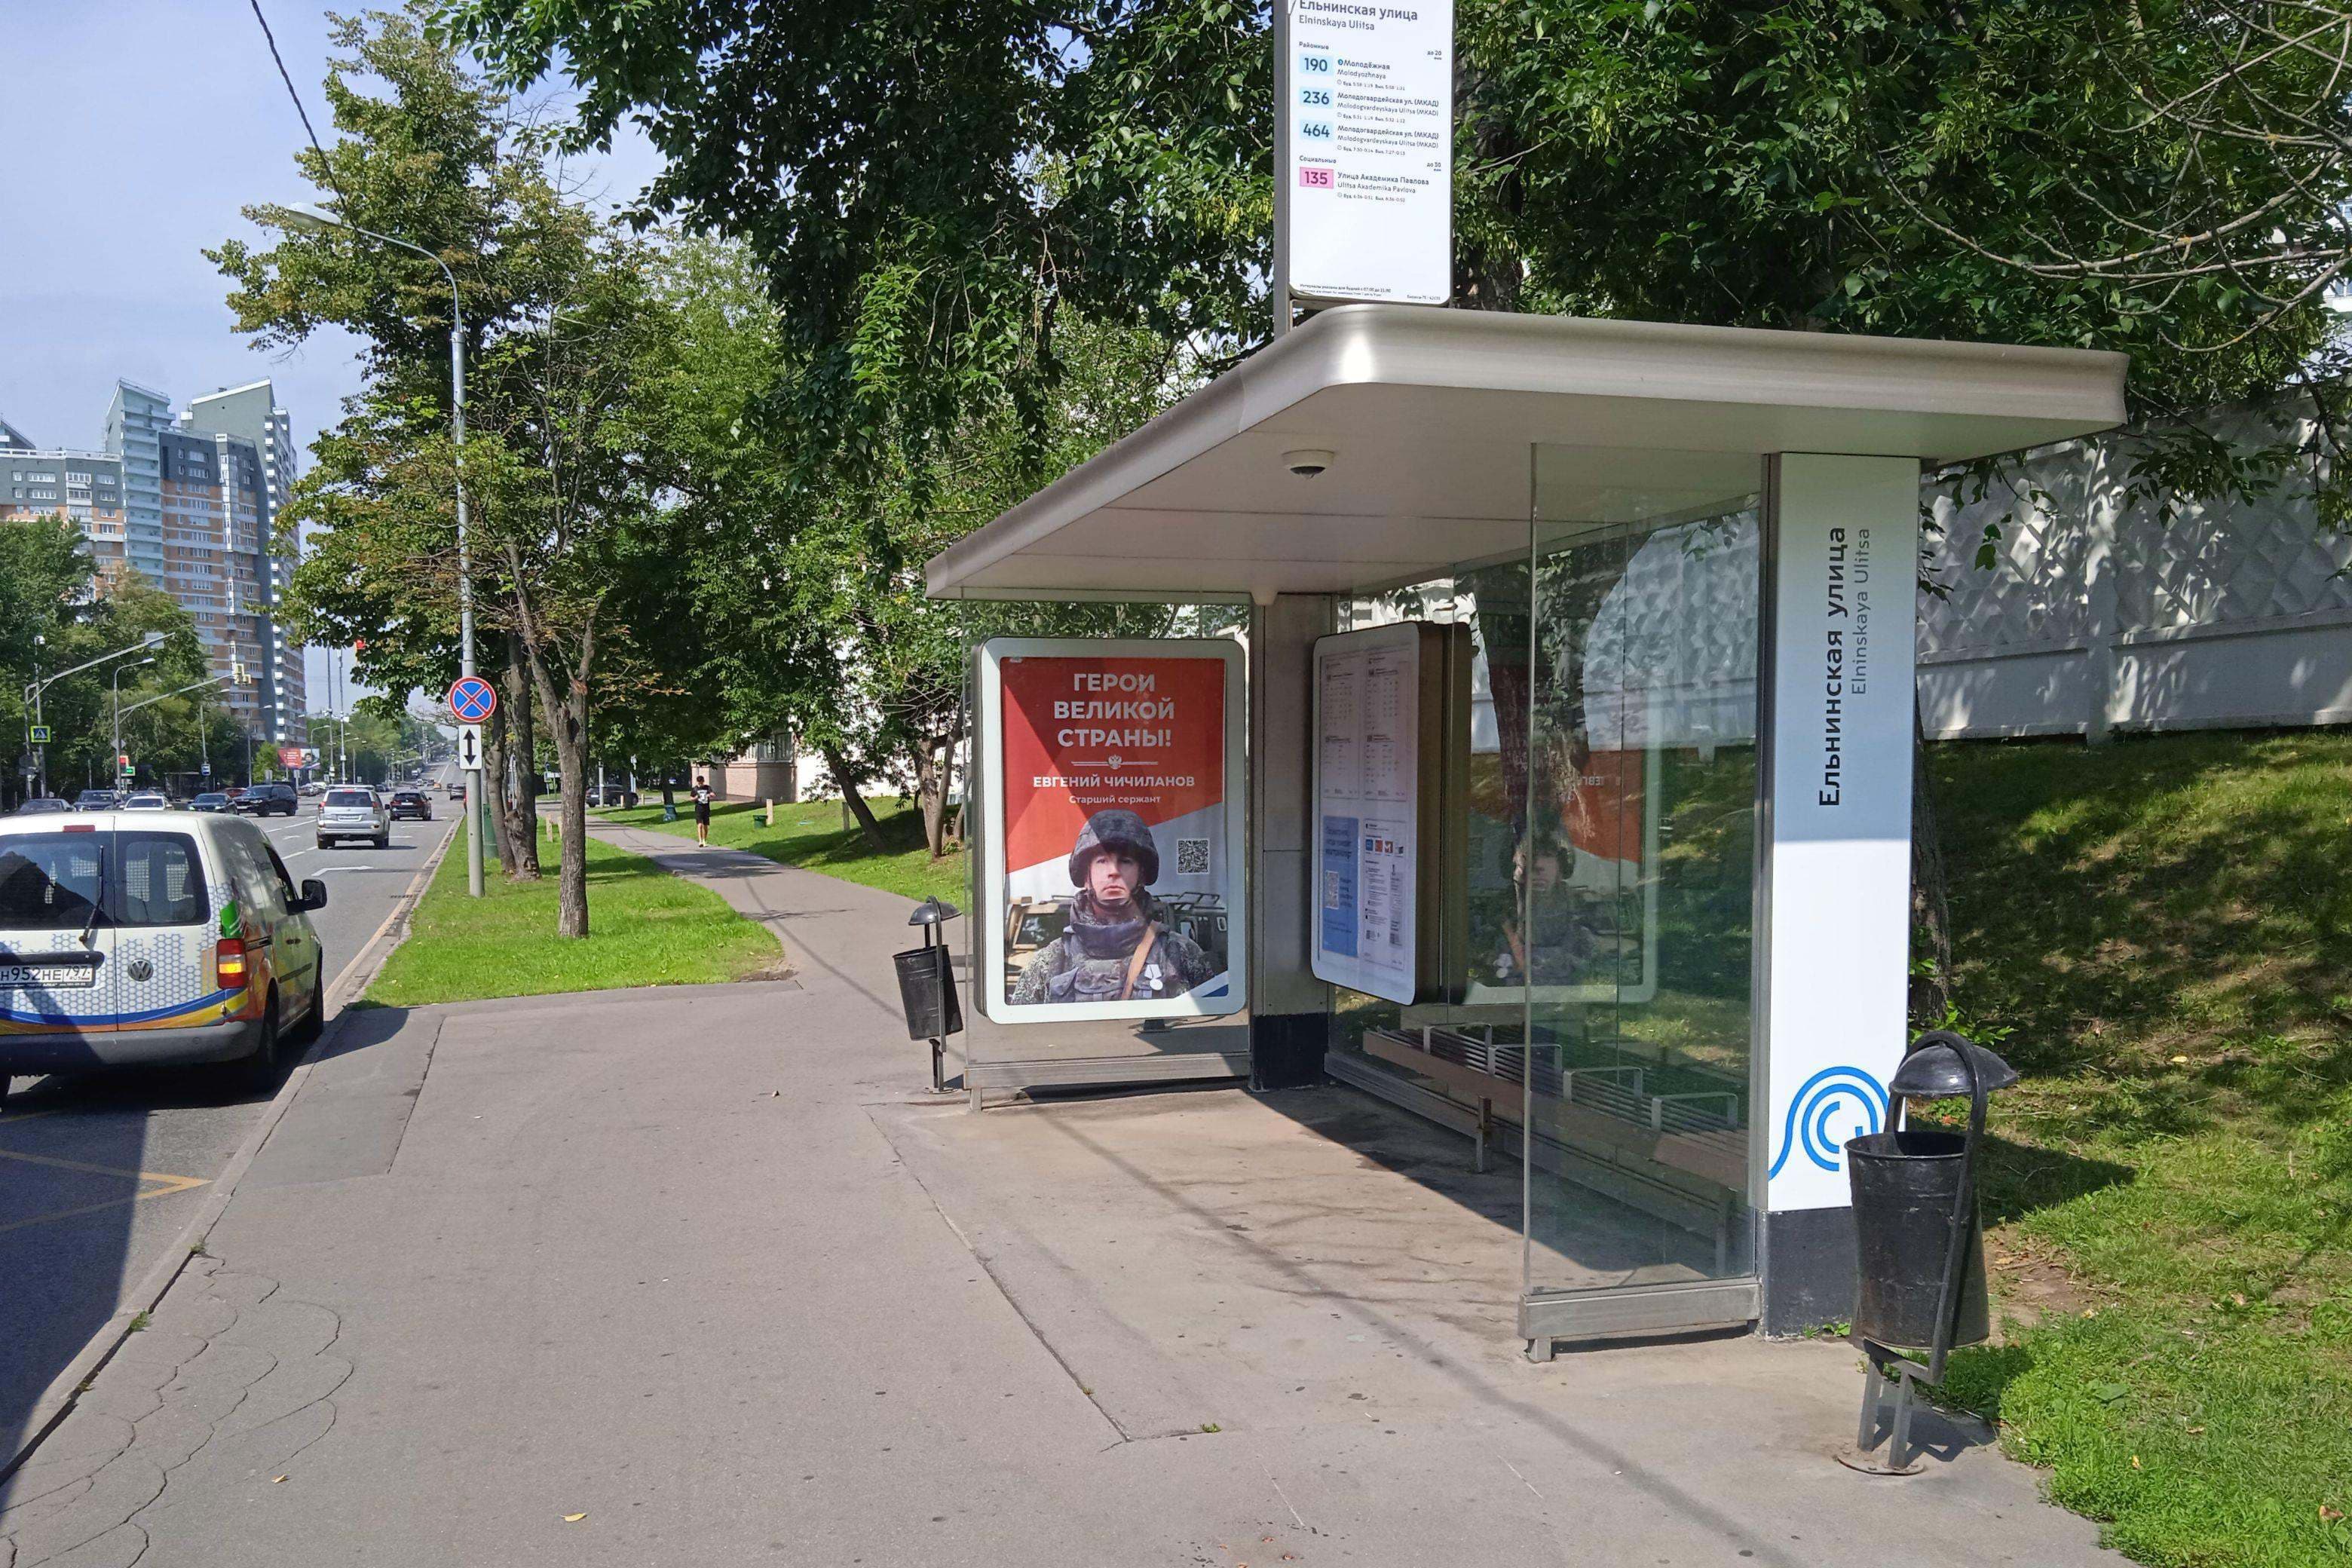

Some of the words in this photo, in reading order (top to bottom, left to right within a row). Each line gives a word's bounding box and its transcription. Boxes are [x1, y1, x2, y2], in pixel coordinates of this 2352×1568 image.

[1299, 0, 1376, 17] Ельнинская
[1379, 7, 1418, 22] улица
[1299, 15, 1346, 29] Elninskaya
[1349, 20, 1375, 30] Ulitsa
[1299, 41, 1329, 50] Районные
[1304, 57, 1328, 72] 190
[1343, 60, 1390, 69] Молодёжная
[1303, 90, 1330, 105] 236
[1337, 92, 1403, 103] Молодогвардейская
[1414, 98, 1439, 107] (МКАД)
[1399, 106, 1416, 115] Ulitsa
[1416, 108, 1438, 116] (MKAD)
[1303, 123, 1330, 138] 464
[1337, 125, 1403, 136] Молодогвардейская
[1414, 130, 1439, 139] (МКАД)
[1299, 155, 1337, 164] Социальные
[1305, 171, 1328, 185] 135
[1337, 172, 1359, 180] Улица
[1360, 173, 1398, 182] Академика
[1400, 176, 1429, 185] Павлова
[1357, 183, 1392, 191] Akademika
[1854, 528, 1870, 583] Ulitsa
[1827, 527, 1848, 618] улица
[1851, 591, 1871, 695] Elninskaya
[1073, 673, 1155, 692] ГЕРОИ
[1054, 697, 1174, 719] ВЕЛИКОЙ
[1819, 630, 1842, 806] Ельнинская
[1058, 729, 1171, 747] СТРАНЫ!
[1033, 773, 1101, 788] ЕВГЕНИЙ
[1104, 776, 1195, 788] ЧИЧИЛАНОВ
[1069, 795, 1116, 805] Старший
[1118, 796, 1161, 805] сержант
[66, 965, 87, 976] 797
